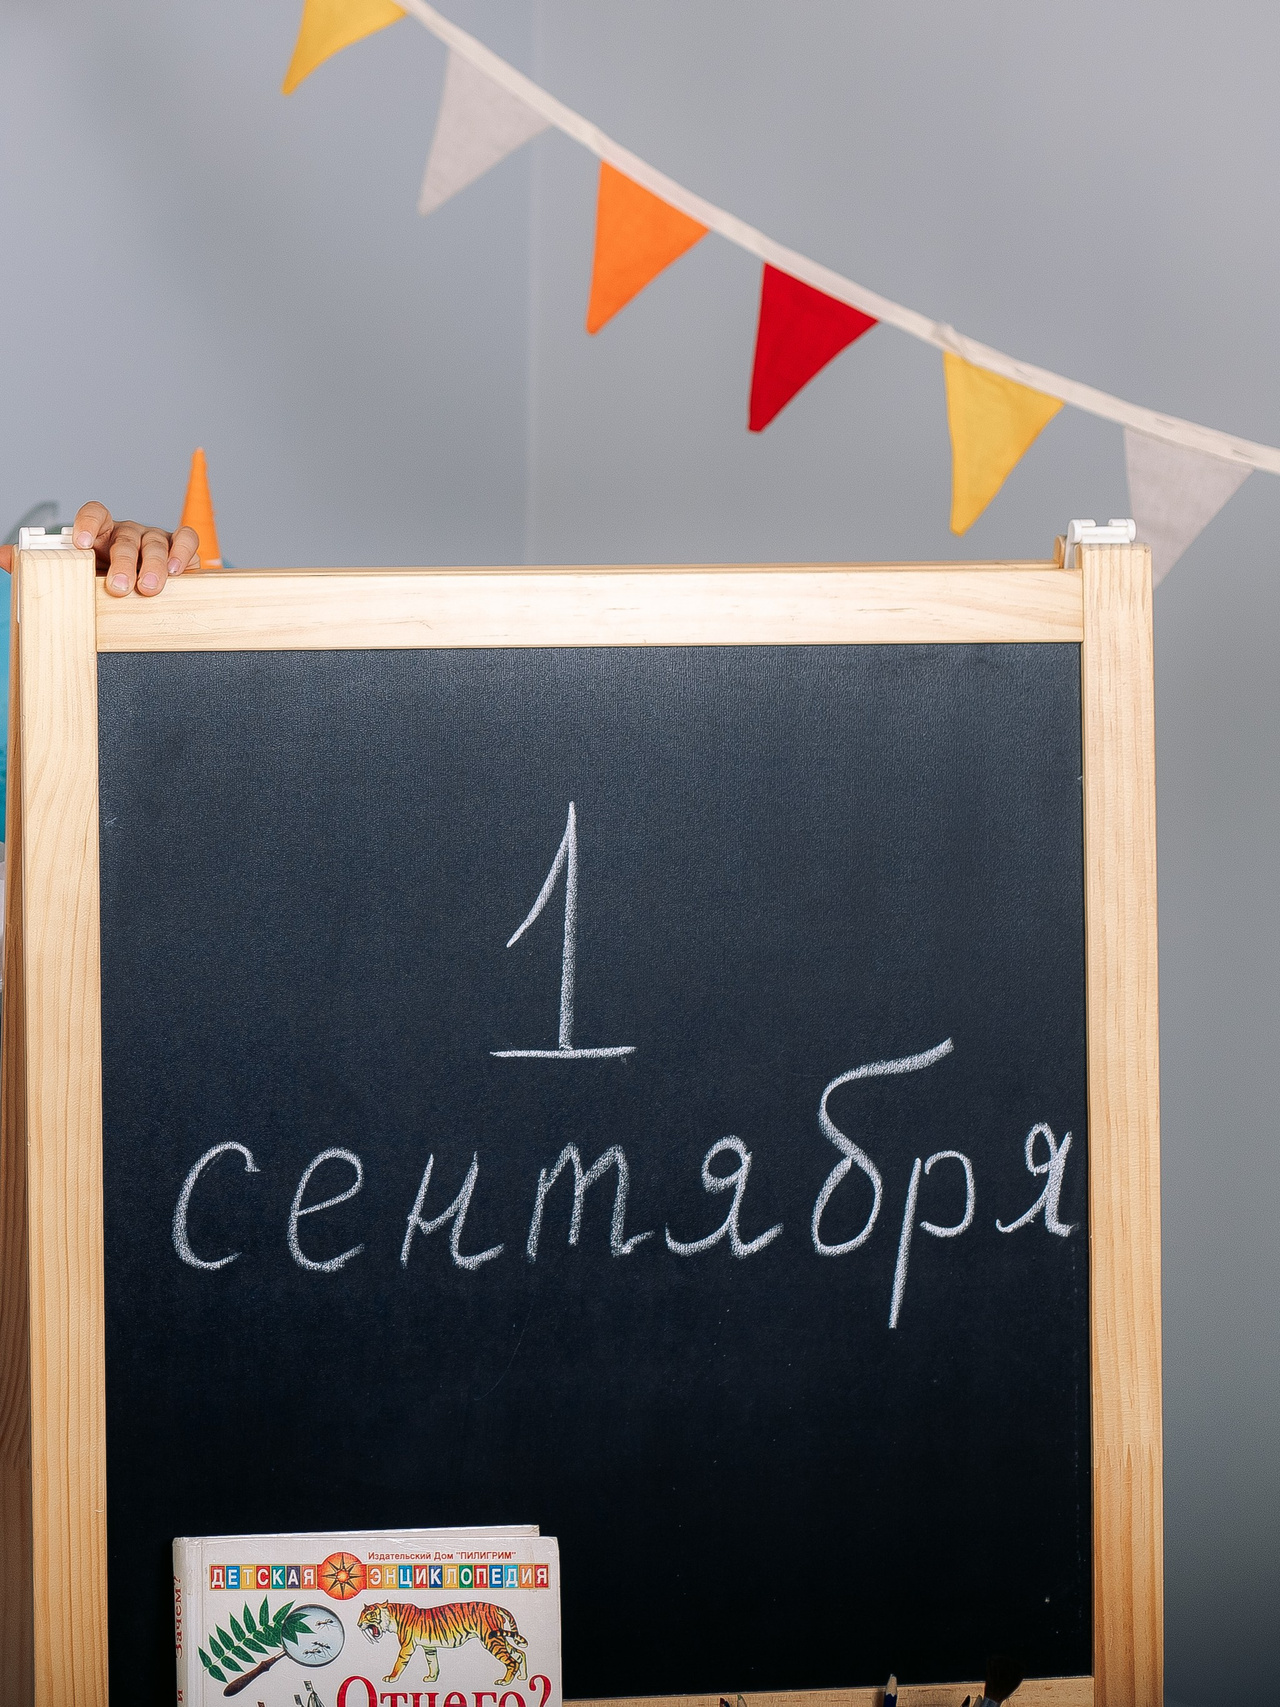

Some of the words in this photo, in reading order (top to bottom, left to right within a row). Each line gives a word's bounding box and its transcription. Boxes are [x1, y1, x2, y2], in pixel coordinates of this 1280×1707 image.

[489, 799, 637, 1060] 1
[172, 1036, 1080, 1329] сентября
[210, 1567, 314, 1589] ДЕТСКАЯ
[369, 1567, 548, 1588] ЭНЦИКЛОПЕДИЯ
[367, 1551, 431, 1561] Издательский
[433, 1551, 454, 1561] Дом
[456, 1551, 517, 1560] "ПИЛИГРИМ"
